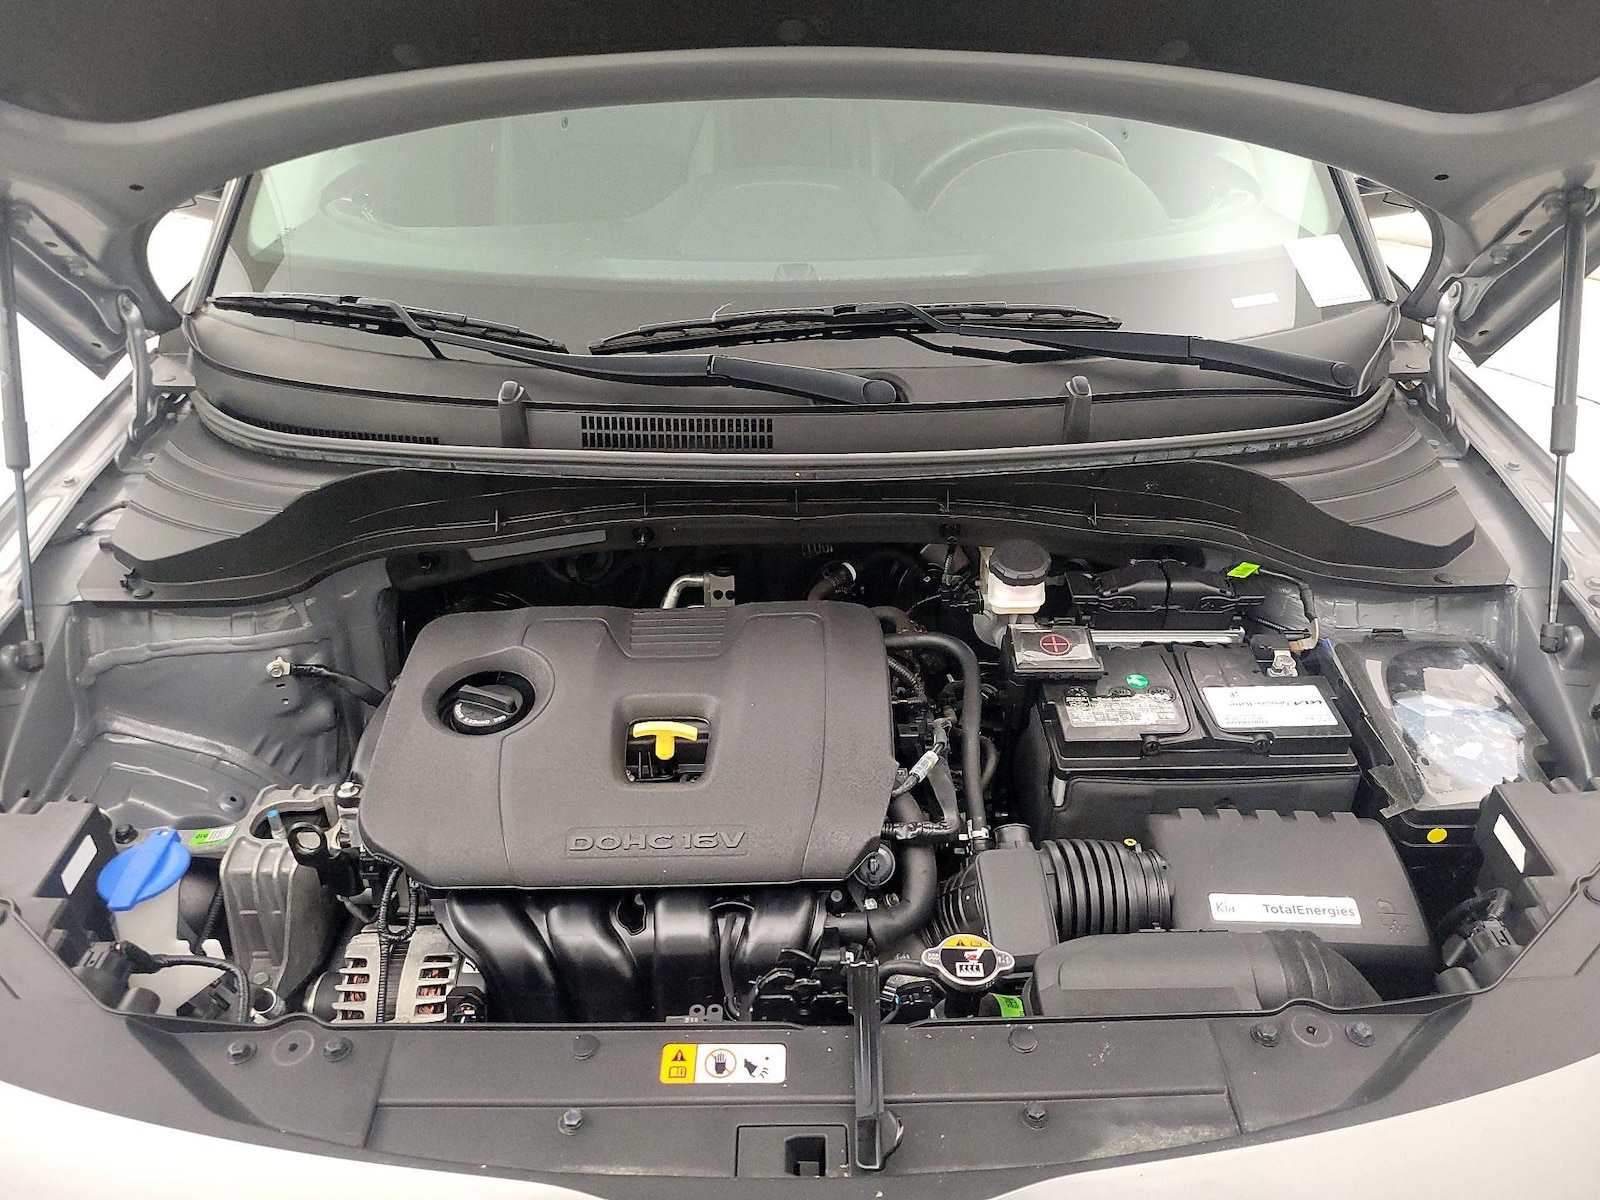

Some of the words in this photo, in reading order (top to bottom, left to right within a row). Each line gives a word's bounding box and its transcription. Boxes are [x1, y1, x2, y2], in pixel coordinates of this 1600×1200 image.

[568, 833, 674, 852] DOHC
[682, 831, 746, 850] 16V
[1215, 901, 1236, 913] Kia
[1261, 903, 1355, 918] TotalEnergies
